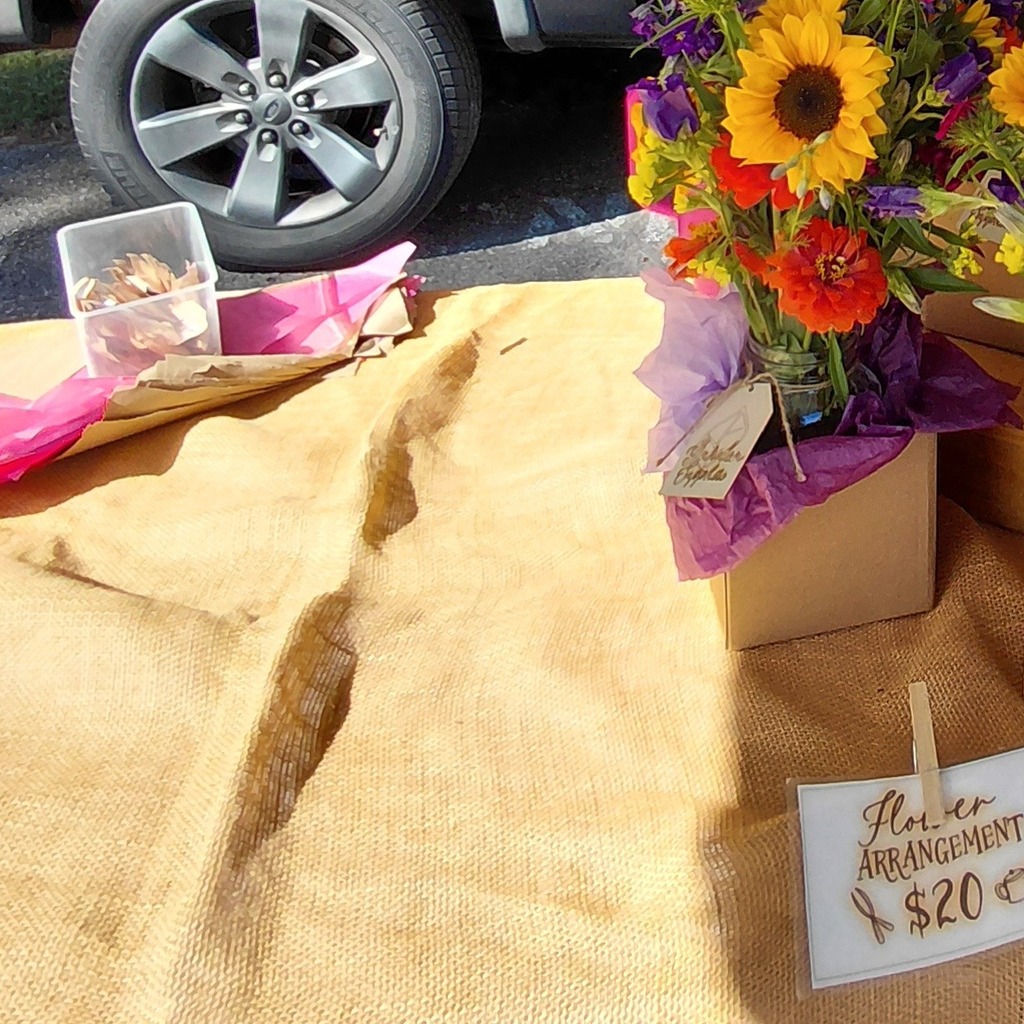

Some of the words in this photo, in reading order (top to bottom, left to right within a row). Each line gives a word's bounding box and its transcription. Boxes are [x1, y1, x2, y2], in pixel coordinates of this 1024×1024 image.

[857, 814, 1024, 883] ARRANGEMENT
[858, 790, 996, 847] Floer
[904, 872, 983, 939] $20
